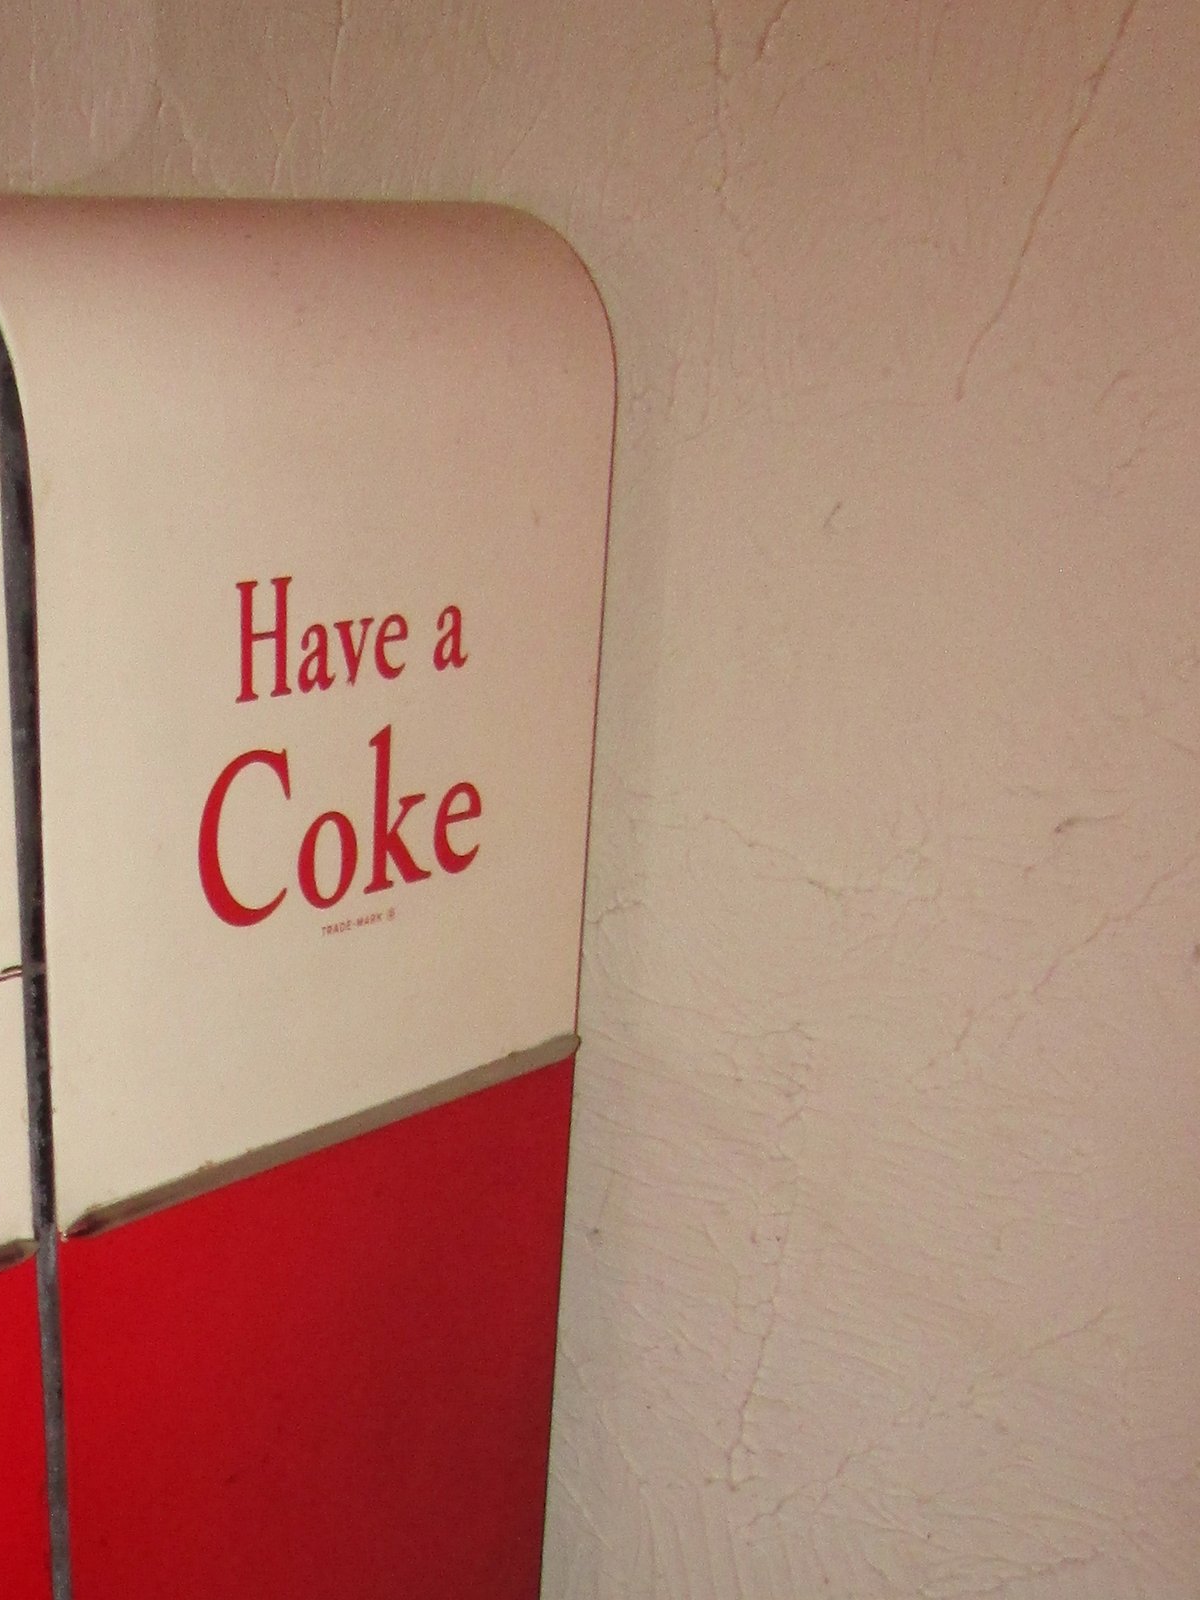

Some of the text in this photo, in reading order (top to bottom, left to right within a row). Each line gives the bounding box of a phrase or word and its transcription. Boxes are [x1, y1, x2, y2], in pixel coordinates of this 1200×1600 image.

[234, 575, 469, 704] Have a
[197, 723, 483, 928] Coke
